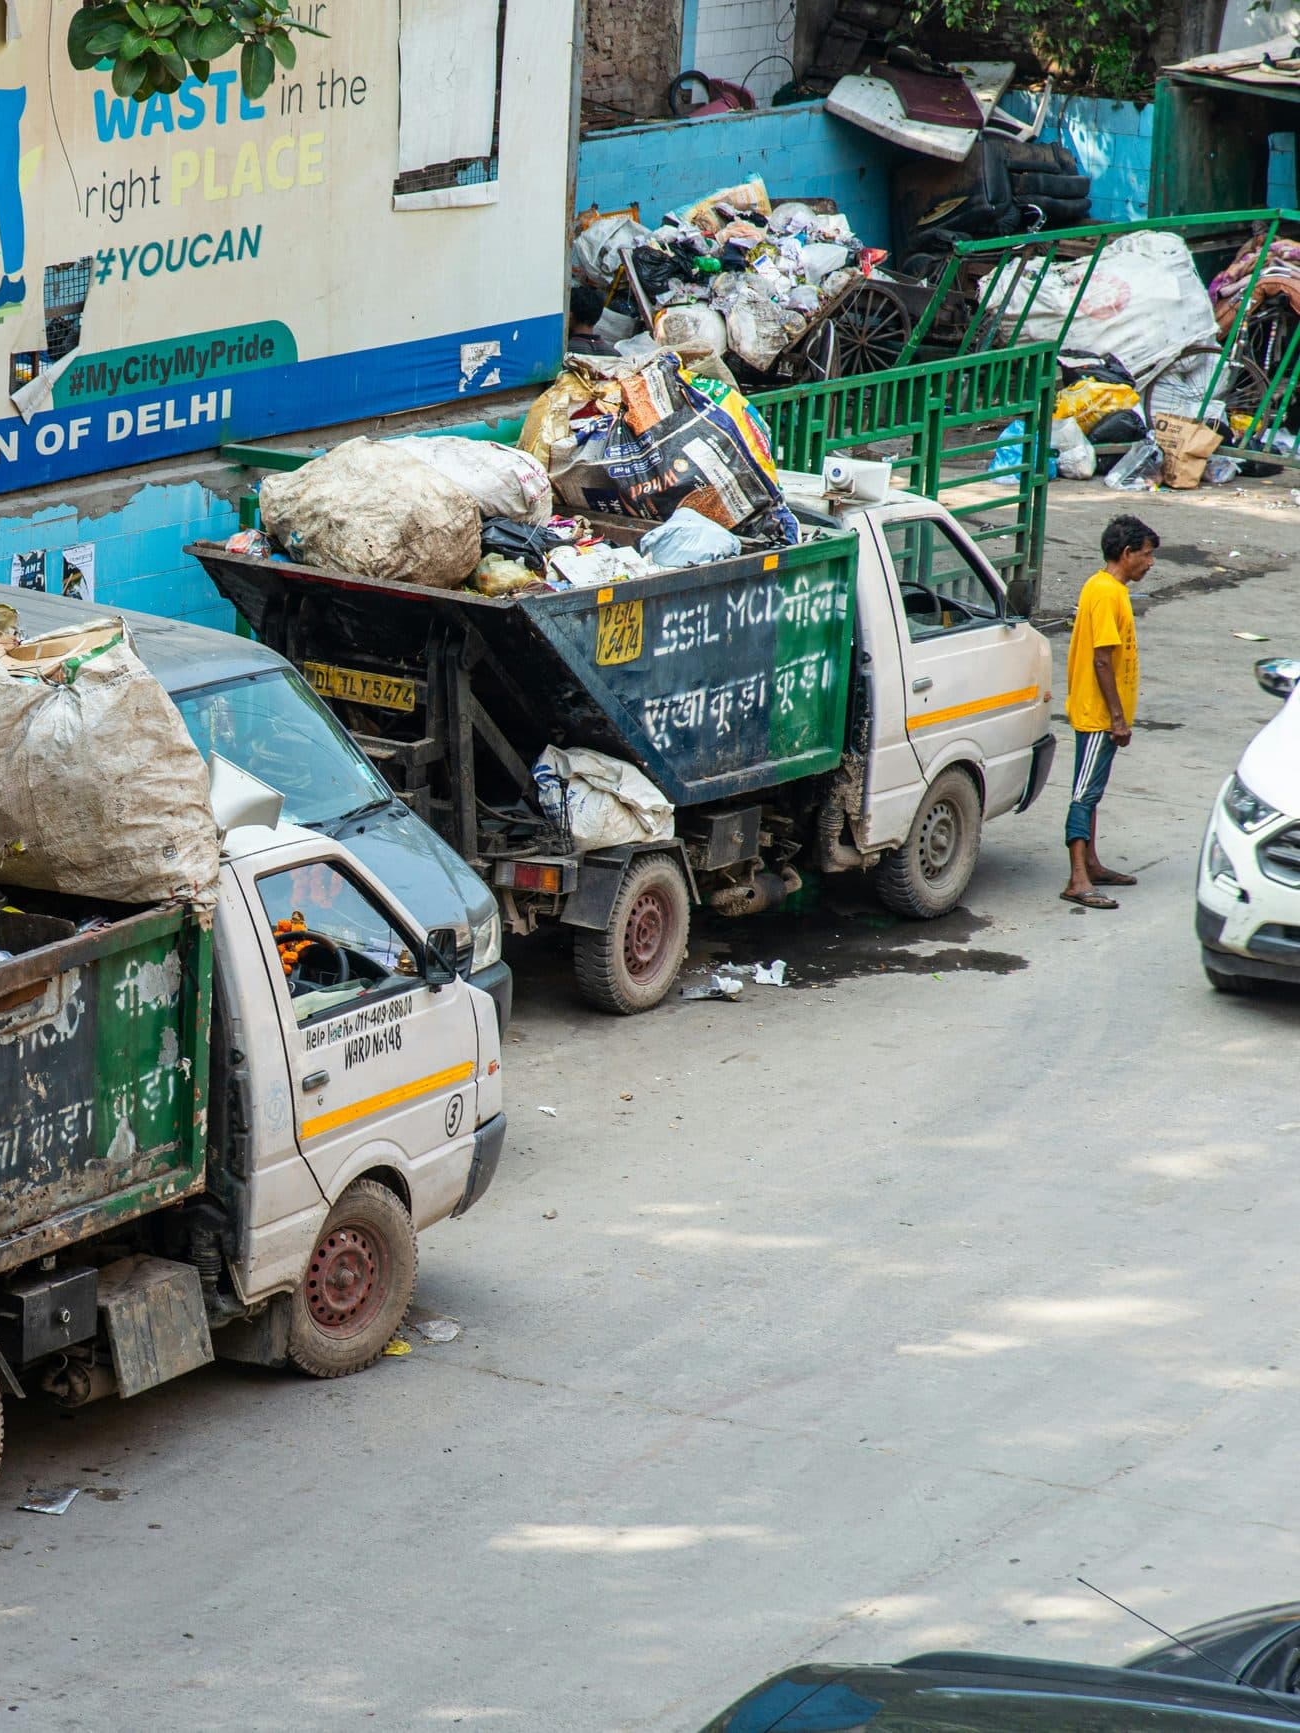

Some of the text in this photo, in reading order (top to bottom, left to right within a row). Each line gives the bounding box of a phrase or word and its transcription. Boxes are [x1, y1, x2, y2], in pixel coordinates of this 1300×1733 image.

[280, 74, 303, 116] in
[316, 68, 367, 111] the
[85, 131, 325, 223] right PLACE
[95, 224, 262, 285] #YOUCAN
[68, 333, 275, 397] #MyCityMyPride
[35, 416, 91, 457] OF
[106, 388, 233, 442] DELHI
[306, 1026, 325, 1051] Help
[344, 1034, 371, 1071] WARD
[384, 1023, 402, 1054] 148
